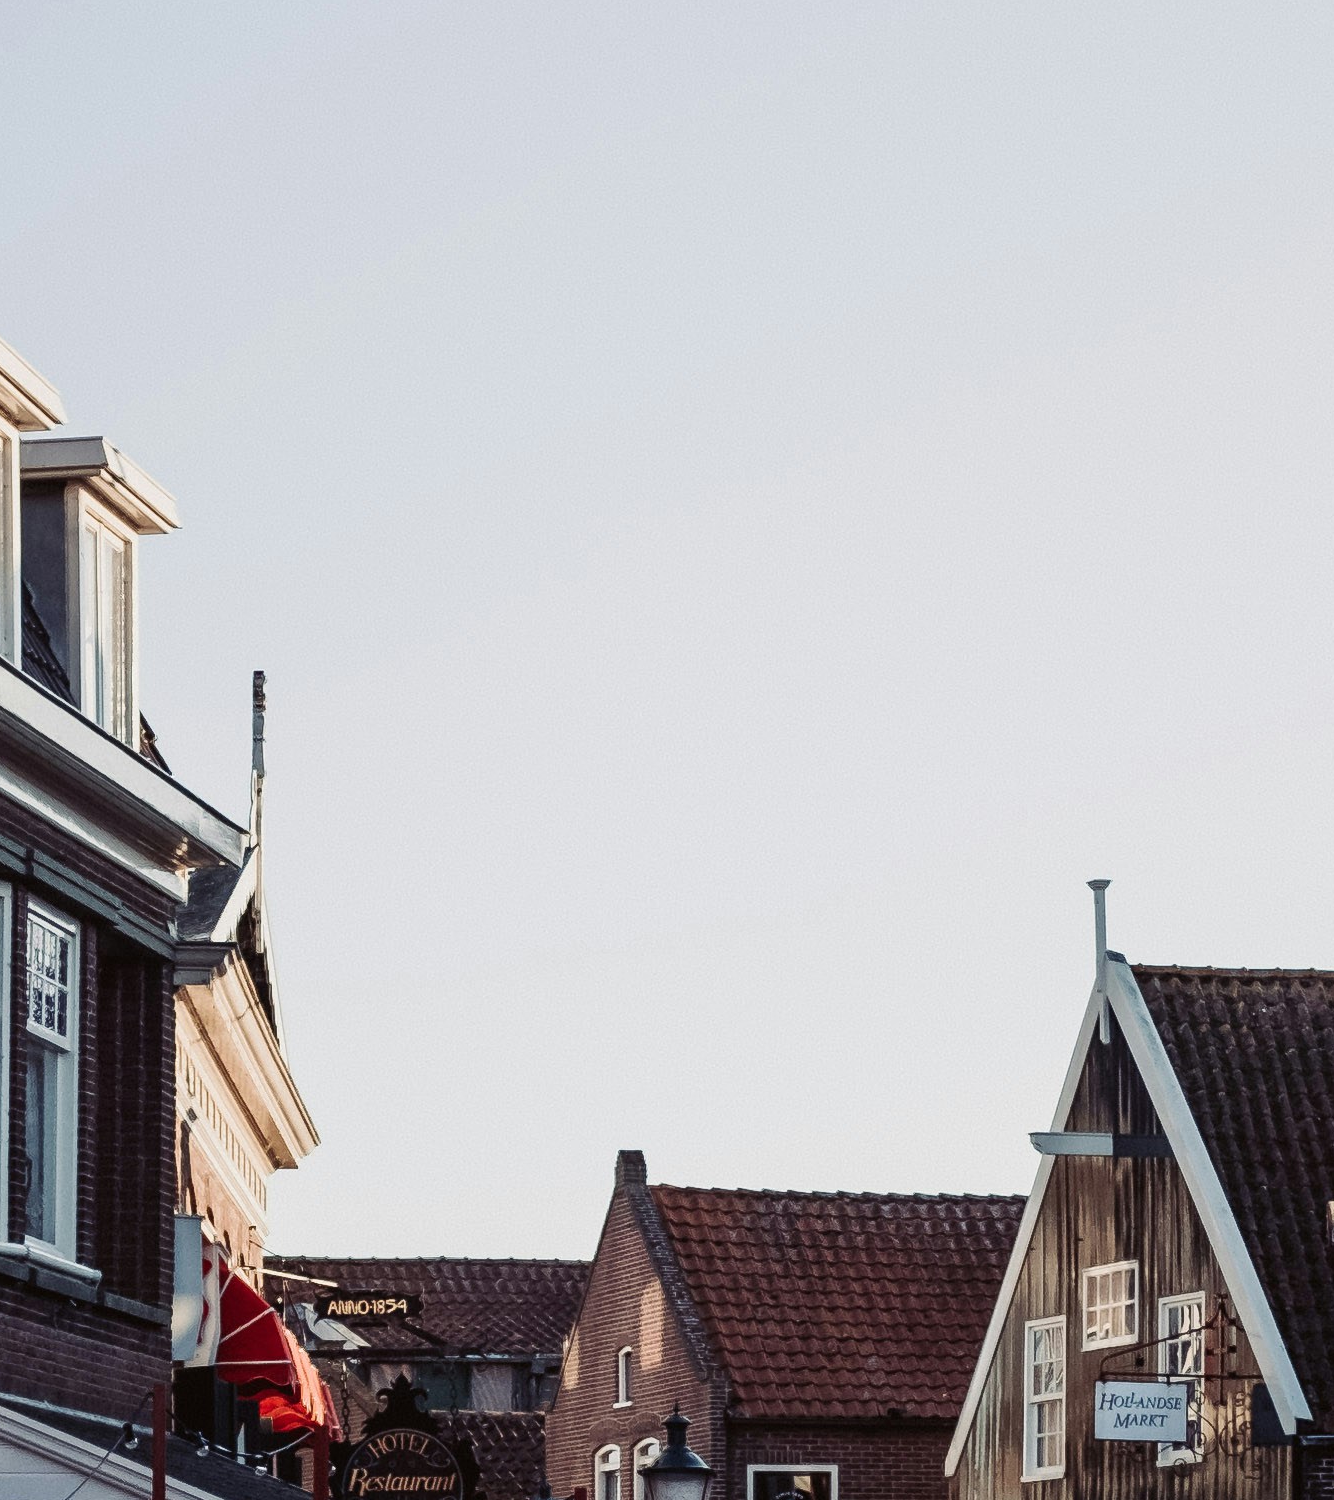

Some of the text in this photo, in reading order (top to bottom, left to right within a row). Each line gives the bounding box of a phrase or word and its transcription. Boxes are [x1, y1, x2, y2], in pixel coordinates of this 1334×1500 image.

[1099, 1391, 1183, 1411] HOLLANDSE
[1113, 1413, 1169, 1429] MARKT
[367, 1432, 432, 1460] HOTEL
[349, 1466, 457, 1497] Restaurant
